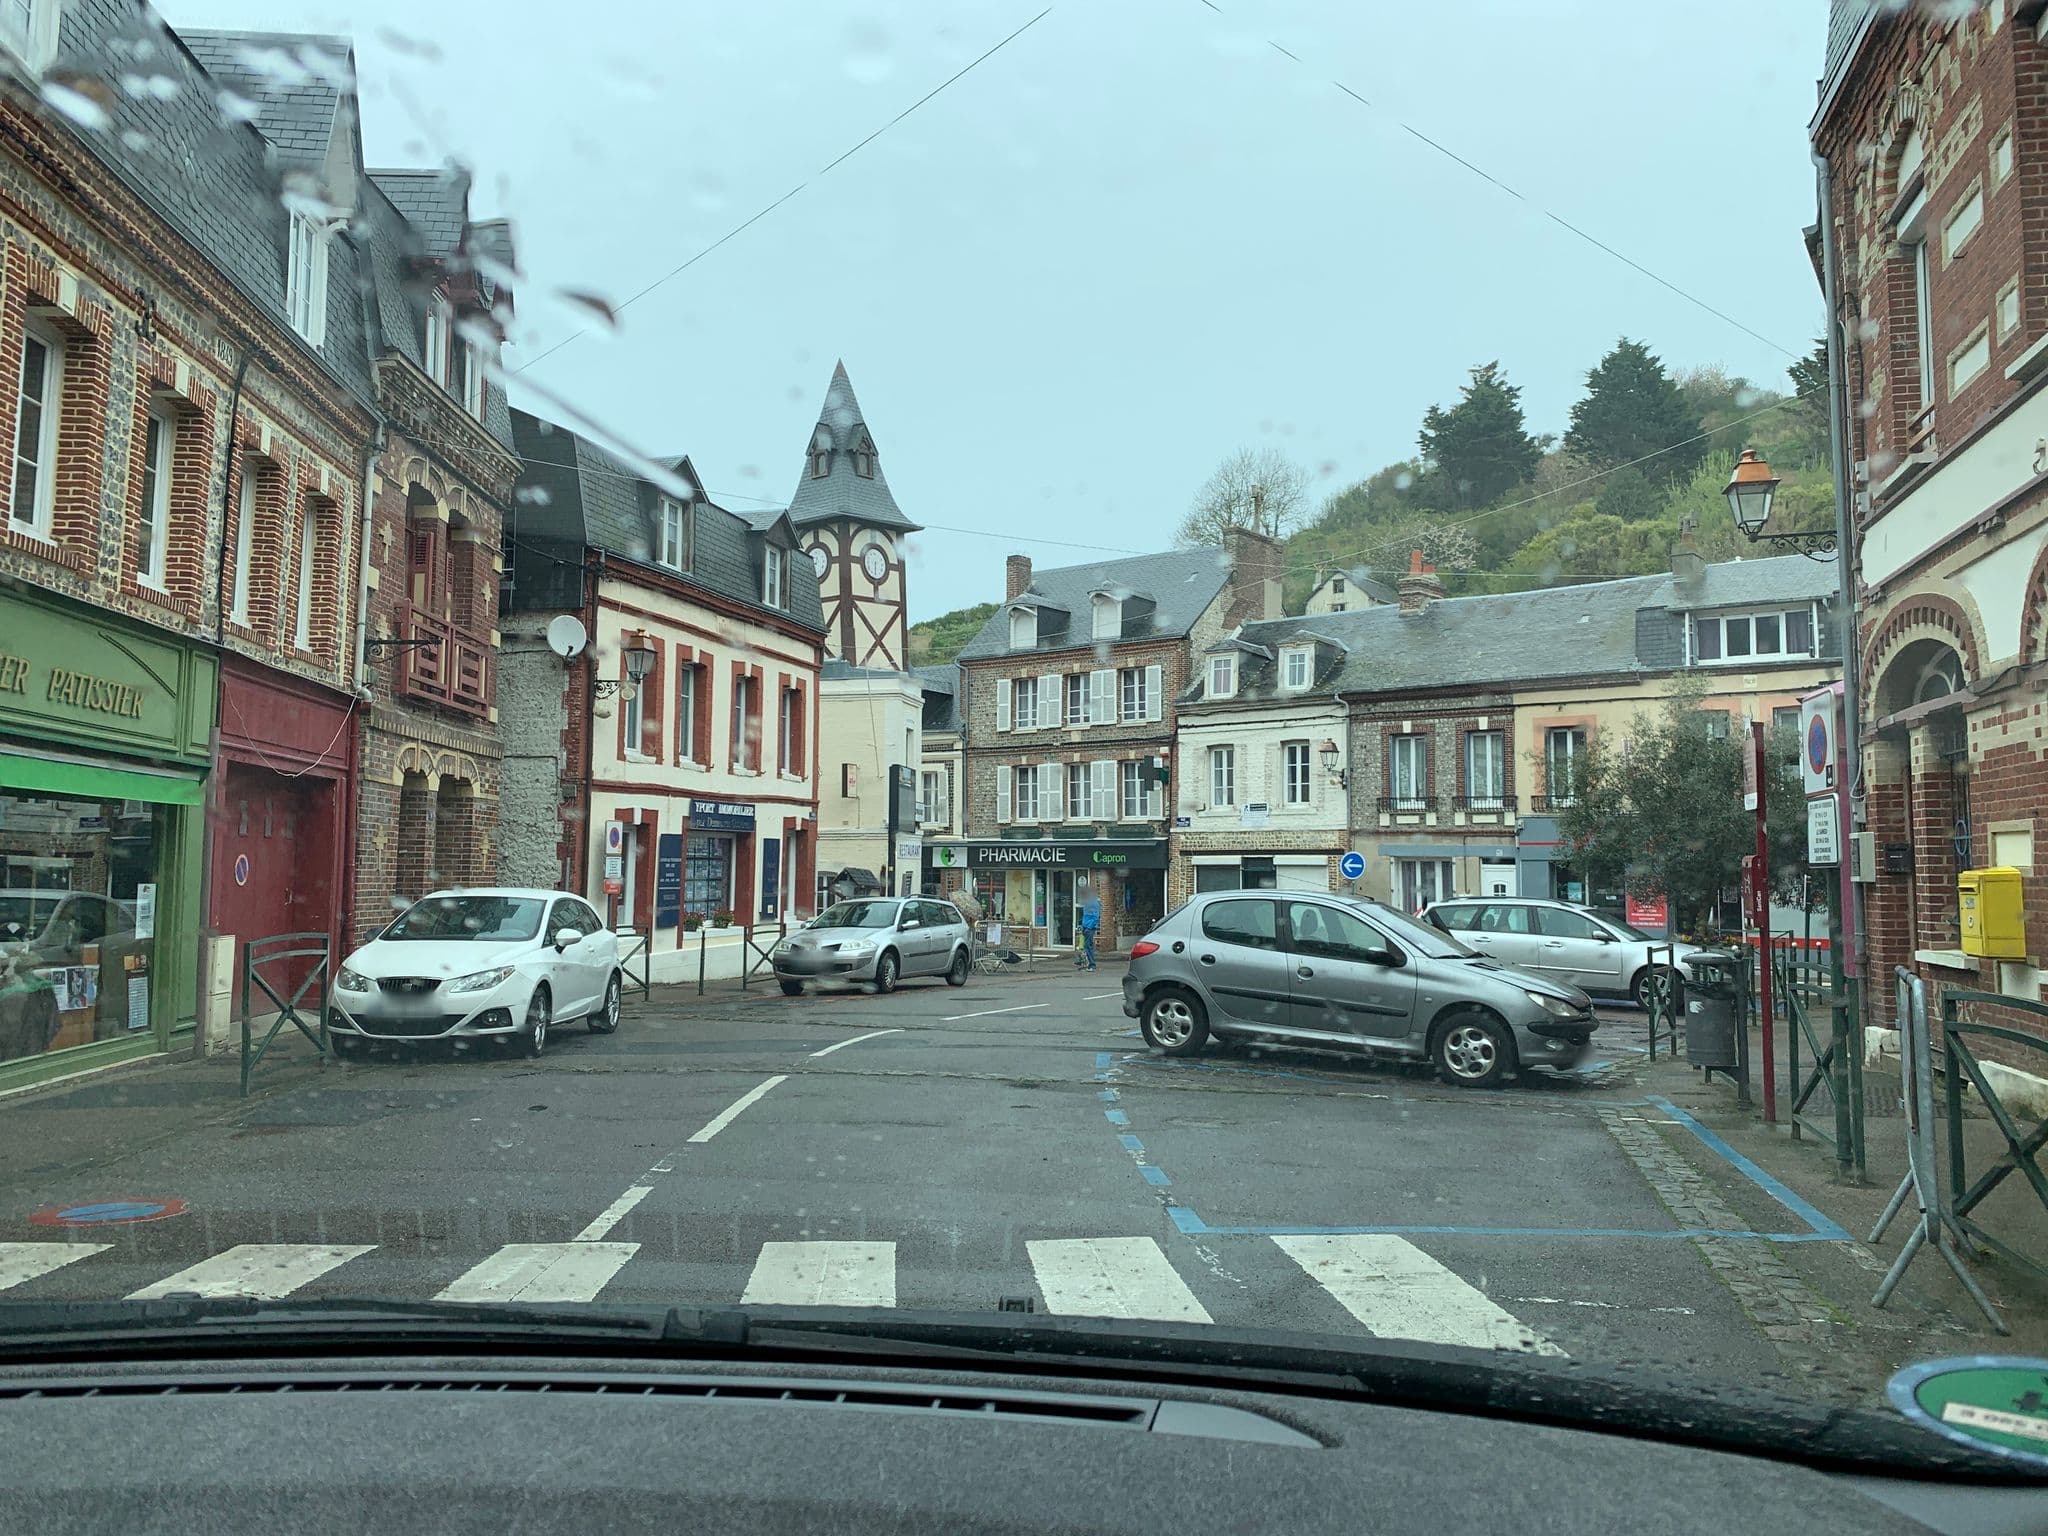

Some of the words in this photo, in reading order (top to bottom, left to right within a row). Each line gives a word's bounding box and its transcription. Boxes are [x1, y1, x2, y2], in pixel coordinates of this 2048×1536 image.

[0, 655, 30, 694] ER
[47, 667, 144, 719] PATISSIER
[979, 847, 1066, 863] PHARMACIE
[1093, 850, 1126, 864] Capron
